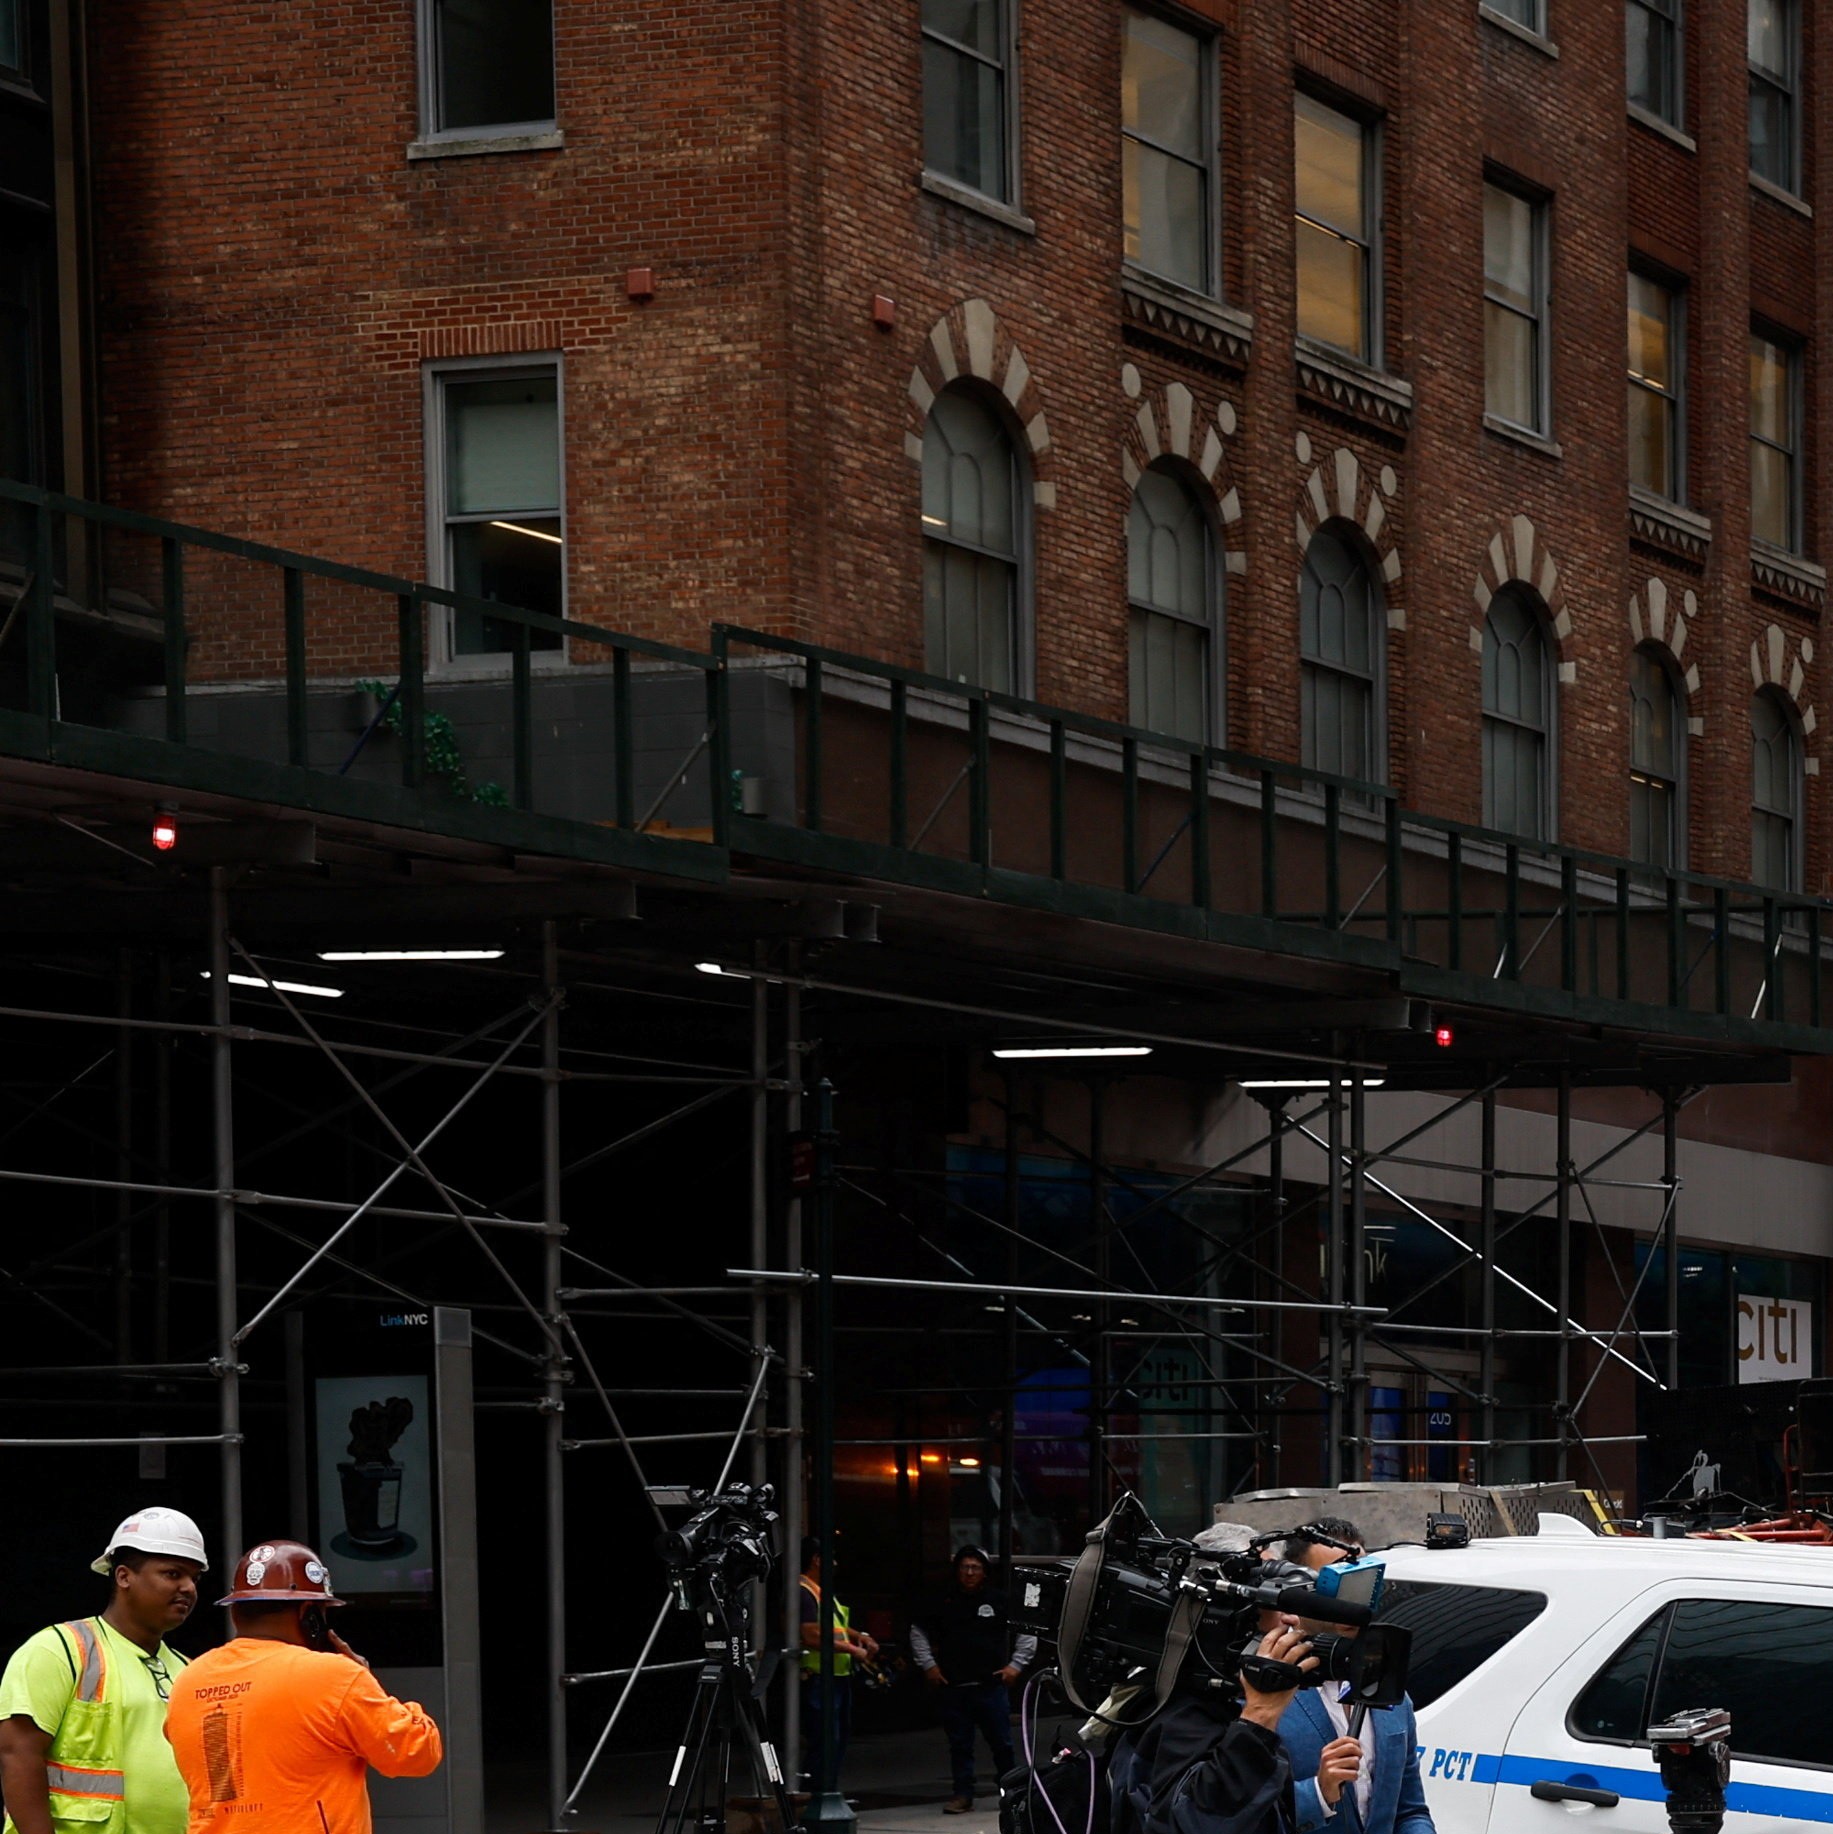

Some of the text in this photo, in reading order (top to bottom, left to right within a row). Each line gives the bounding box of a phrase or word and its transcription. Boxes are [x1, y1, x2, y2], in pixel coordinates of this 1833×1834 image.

[380, 1314, 428, 1326] LinkNYC
[731, 1636, 741, 1667] SONY
[195, 1685, 231, 1700] TOPPED
[232, 1682, 252, 1694] OUT
[1429, 1748, 1473, 1780] PCT
